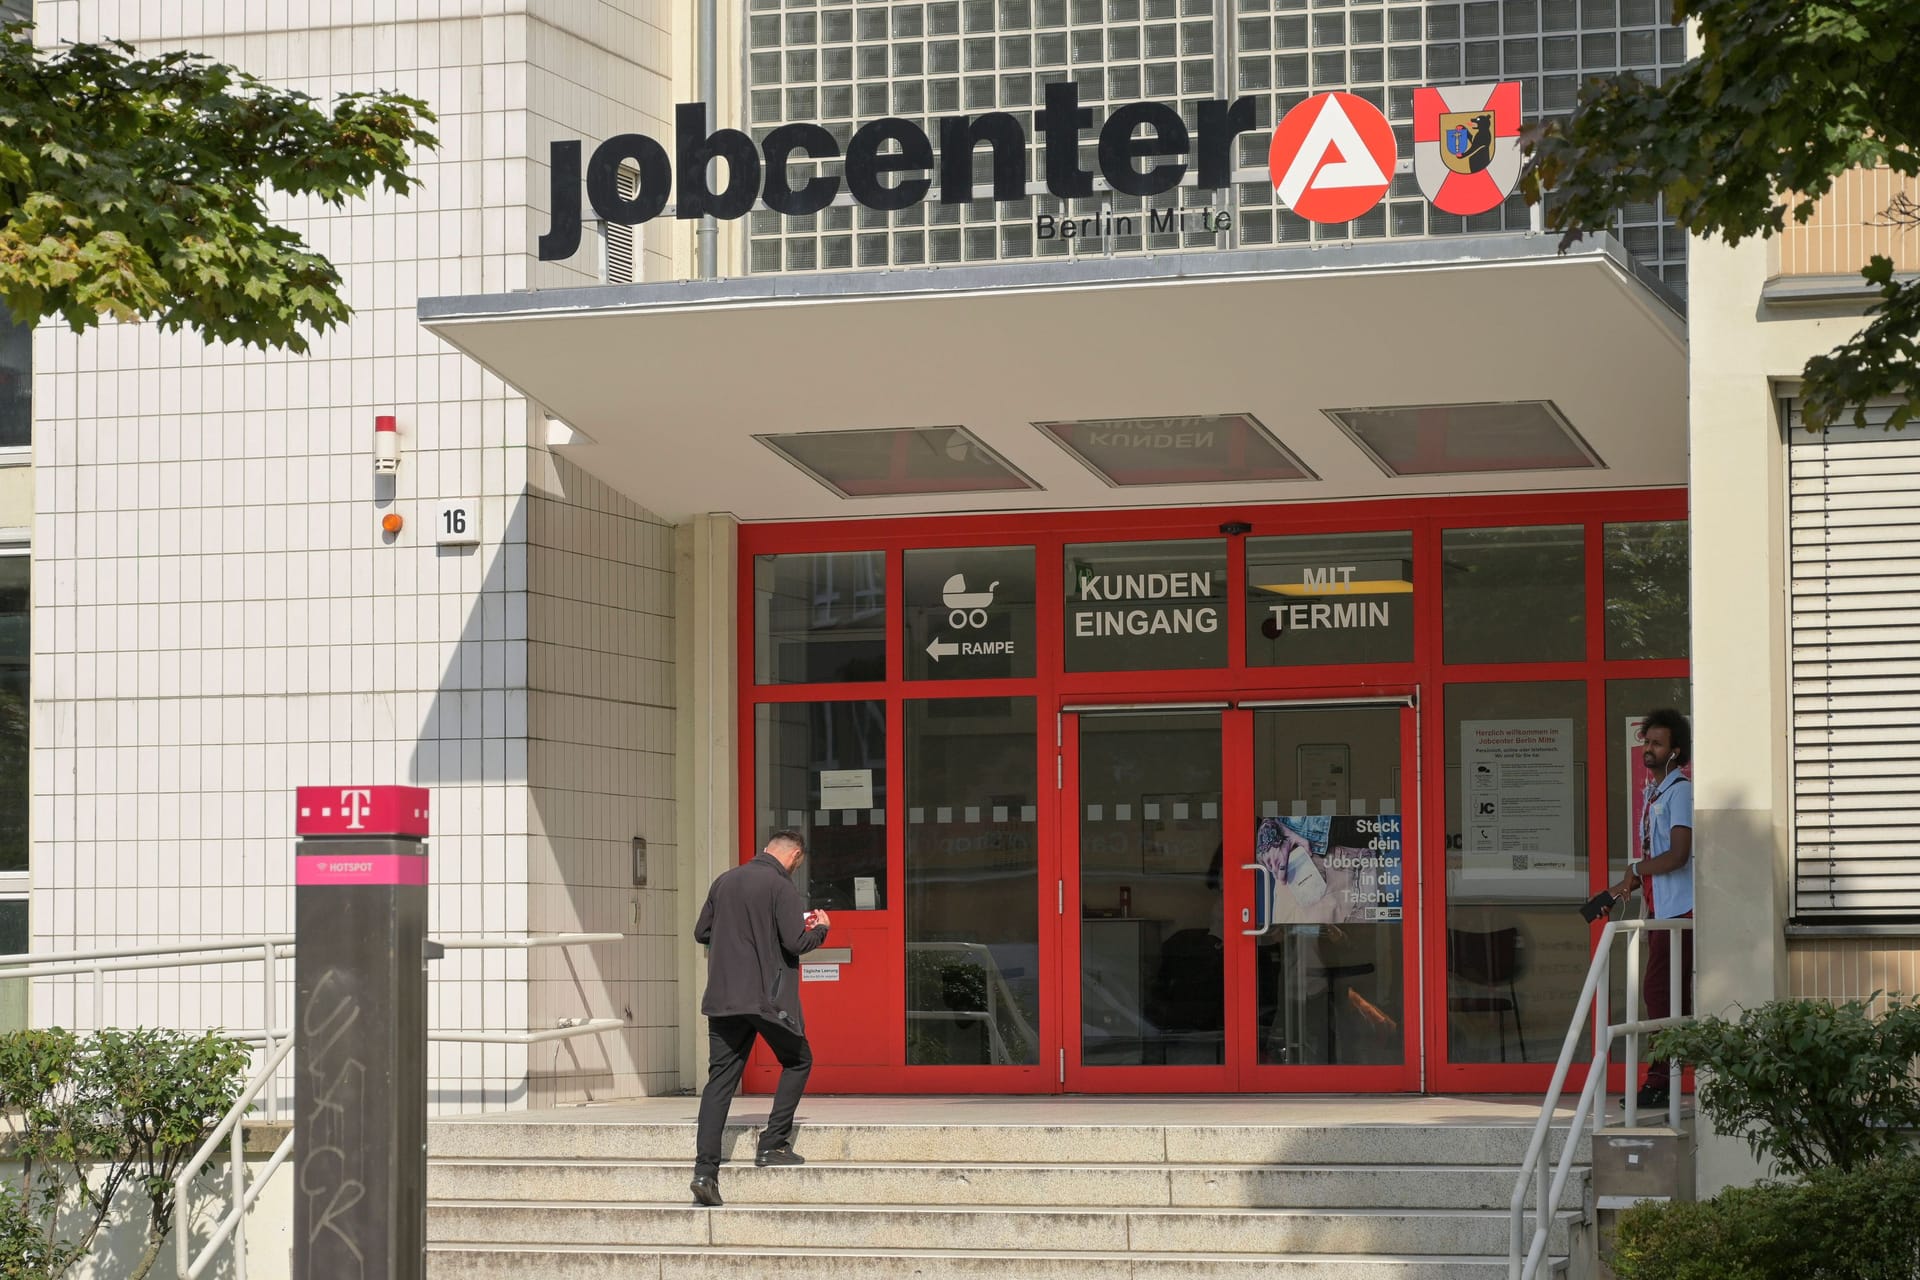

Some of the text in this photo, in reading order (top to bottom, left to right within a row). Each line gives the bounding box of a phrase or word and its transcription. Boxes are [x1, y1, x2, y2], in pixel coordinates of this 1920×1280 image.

[539, 82, 1256, 261] jobcenter
[1037, 211, 1132, 240] Berlin
[443, 508, 466, 534] 16
[1080, 571, 1211, 601] KUNDEN
[1303, 566, 1356, 593] MIT
[1075, 607, 1218, 637] EINGANG
[1269, 601, 1390, 631] TERMIN
[962, 641, 1015, 656] RAMPE
[1475, 729, 1504, 738] Herzlich
[1505, 729, 1548, 737] willkommen
[1478, 737, 1516, 746] Jobcenter
[1516, 737, 1537, 745] Berlin
[341, 789, 371, 829] T
[1356, 819, 1400, 833] Steck
[1368, 837, 1400, 850] dein
[330, 862, 373, 872] HOTSPOT
[1323, 855, 1400, 868] Jobcenter
[1361, 872, 1400, 885] in die
[1341, 889, 1400, 903] Tasche!
